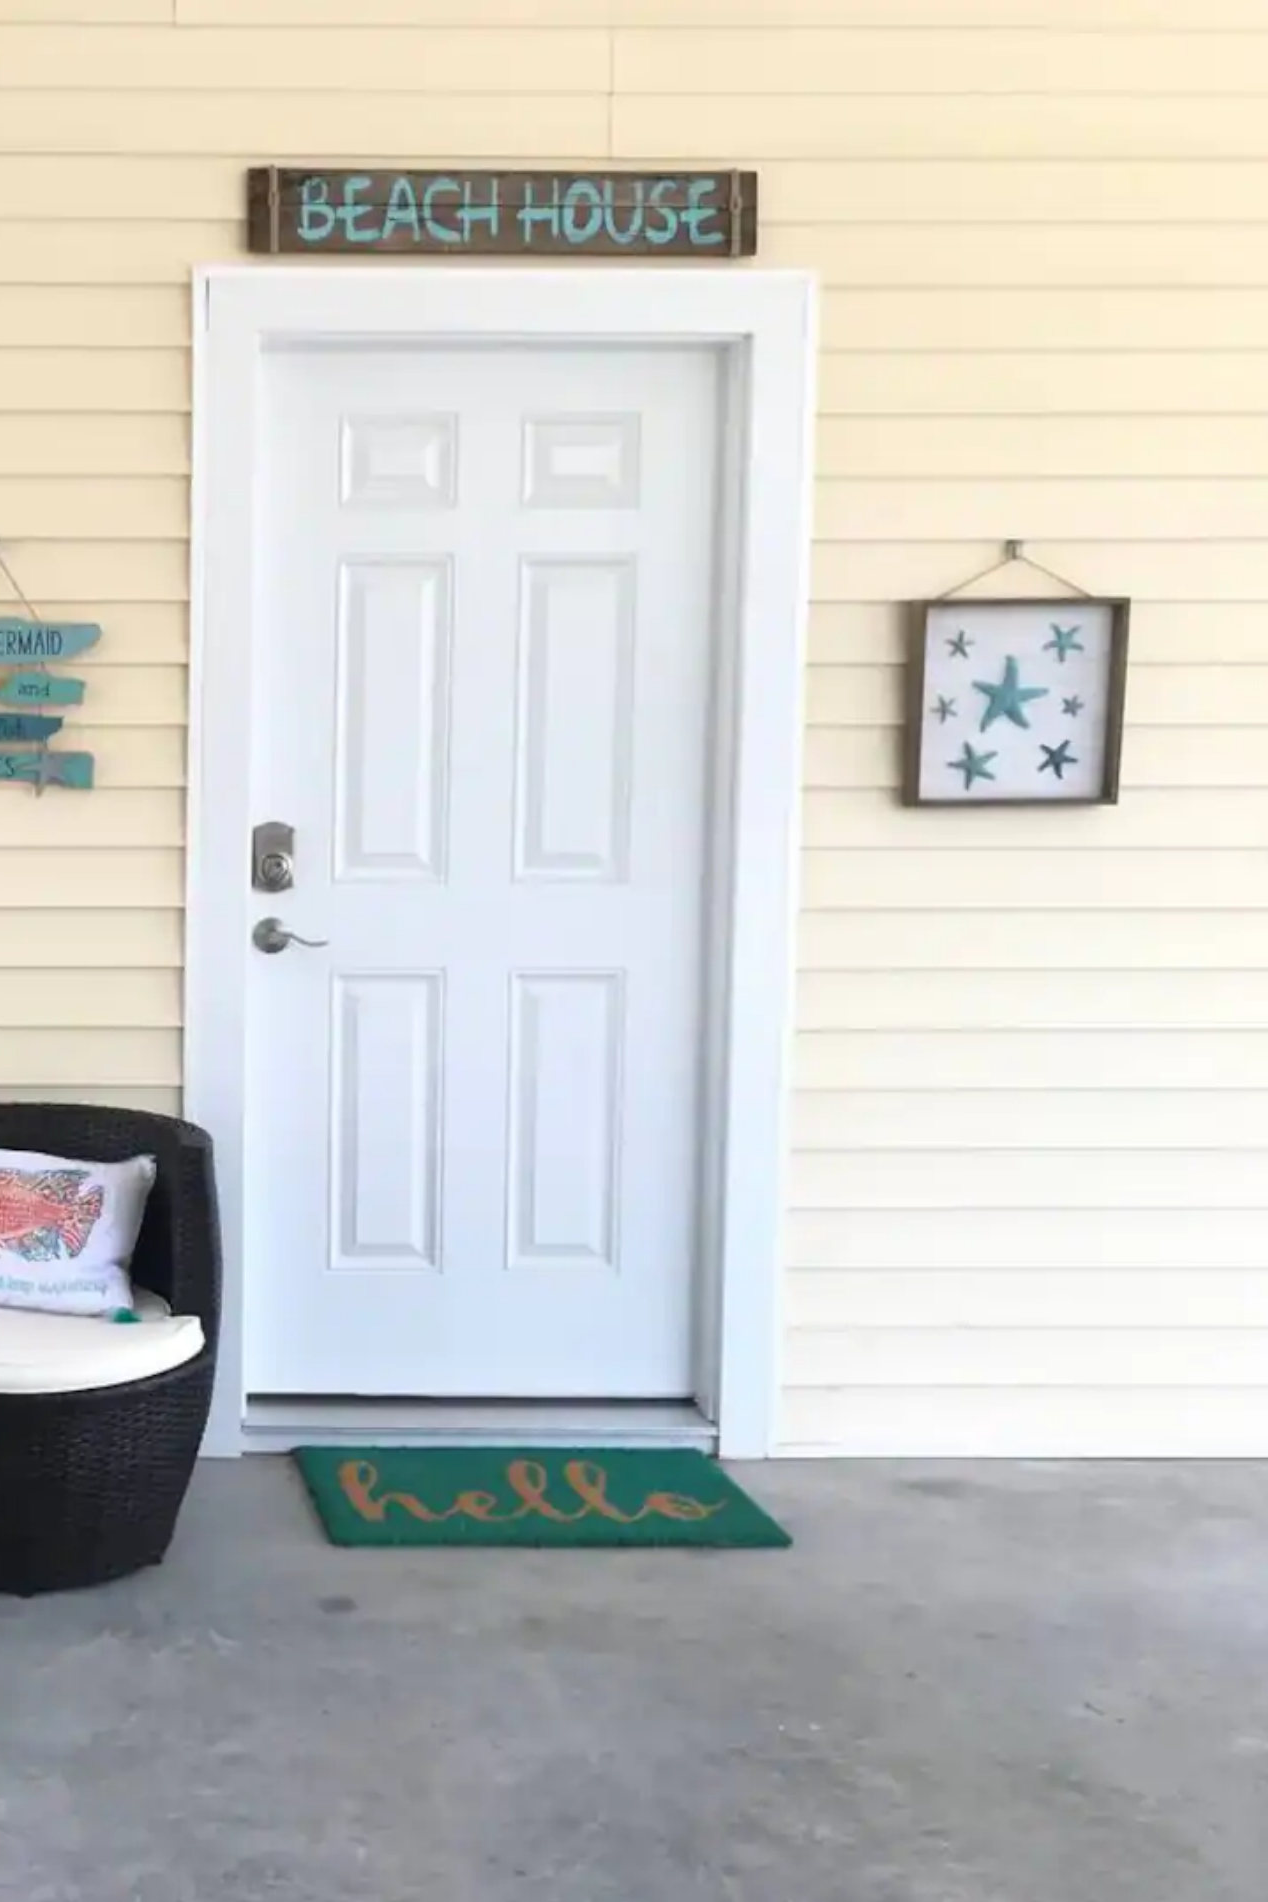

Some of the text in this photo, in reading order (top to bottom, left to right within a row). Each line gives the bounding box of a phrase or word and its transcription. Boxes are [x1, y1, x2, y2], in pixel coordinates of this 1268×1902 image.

[297, 176, 724, 245] BEACH HOUSE
[339, 1460, 728, 1521] hello
